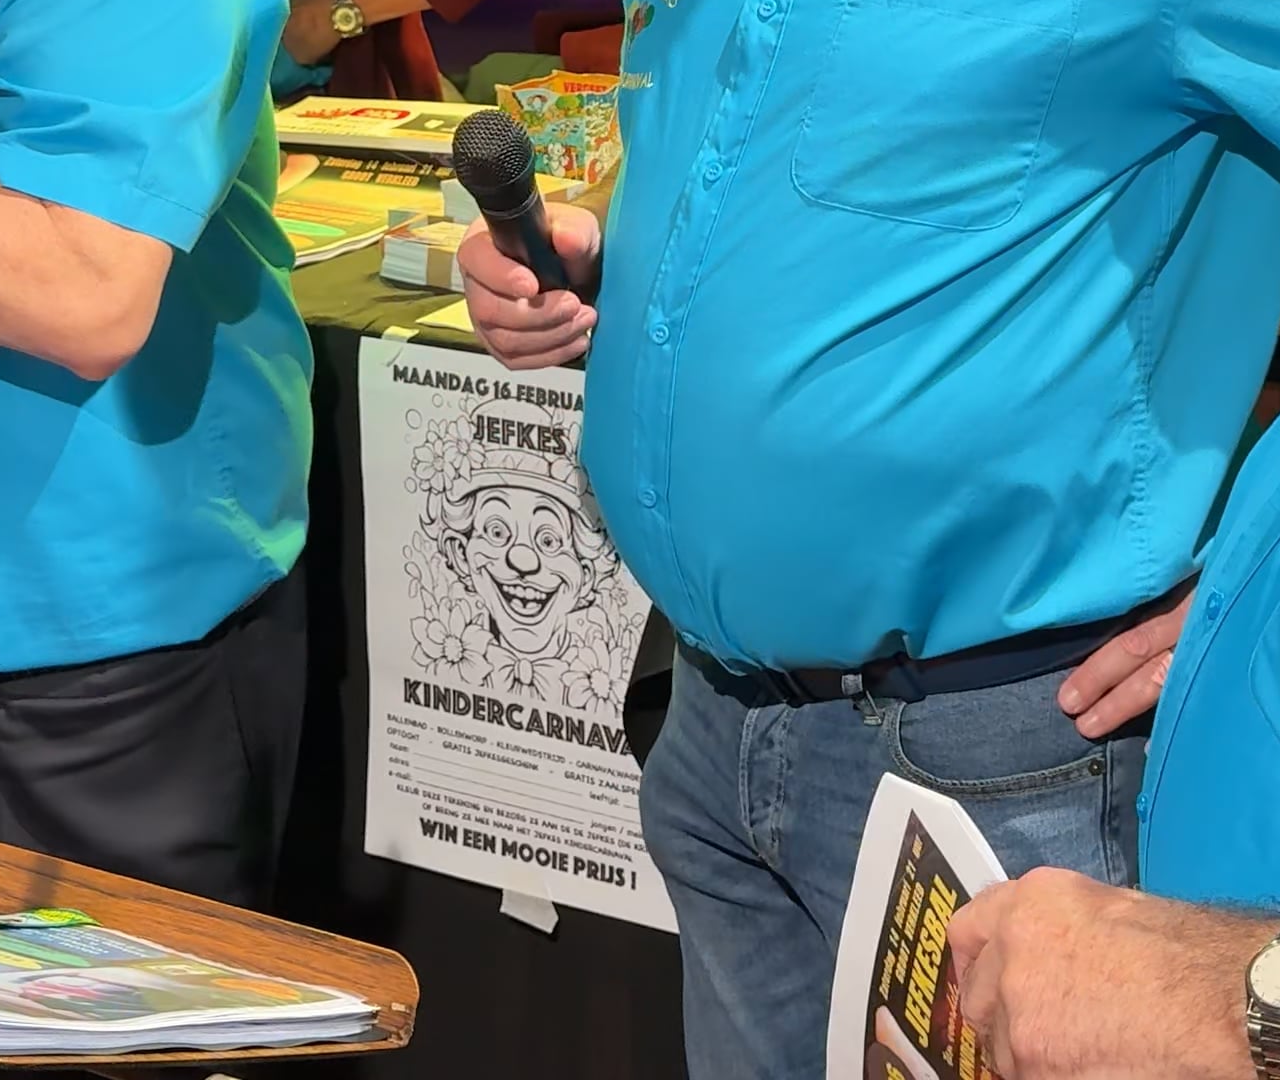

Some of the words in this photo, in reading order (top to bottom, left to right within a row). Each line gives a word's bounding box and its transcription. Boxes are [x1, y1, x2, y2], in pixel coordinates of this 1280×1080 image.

[393, 364, 488, 398] MAANDAG
[493, 380, 511, 401] 16
[472, 414, 568, 456] JEFKES
[442, 740, 472, 755] GRATIS
[563, 770, 596, 786] GRATIS
[492, 820, 515, 833] NAAR
[516, 825, 532, 837] HET
[541, 820, 558, 831] AAN
[418, 815, 459, 845] WIN
[462, 826, 497, 855] EEN
[500, 837, 570, 874] MOOIE
[572, 855, 627, 888] PRIJS
[630, 870, 638, 890] !
[904, 872, 959, 1049] JEFKESBAL
